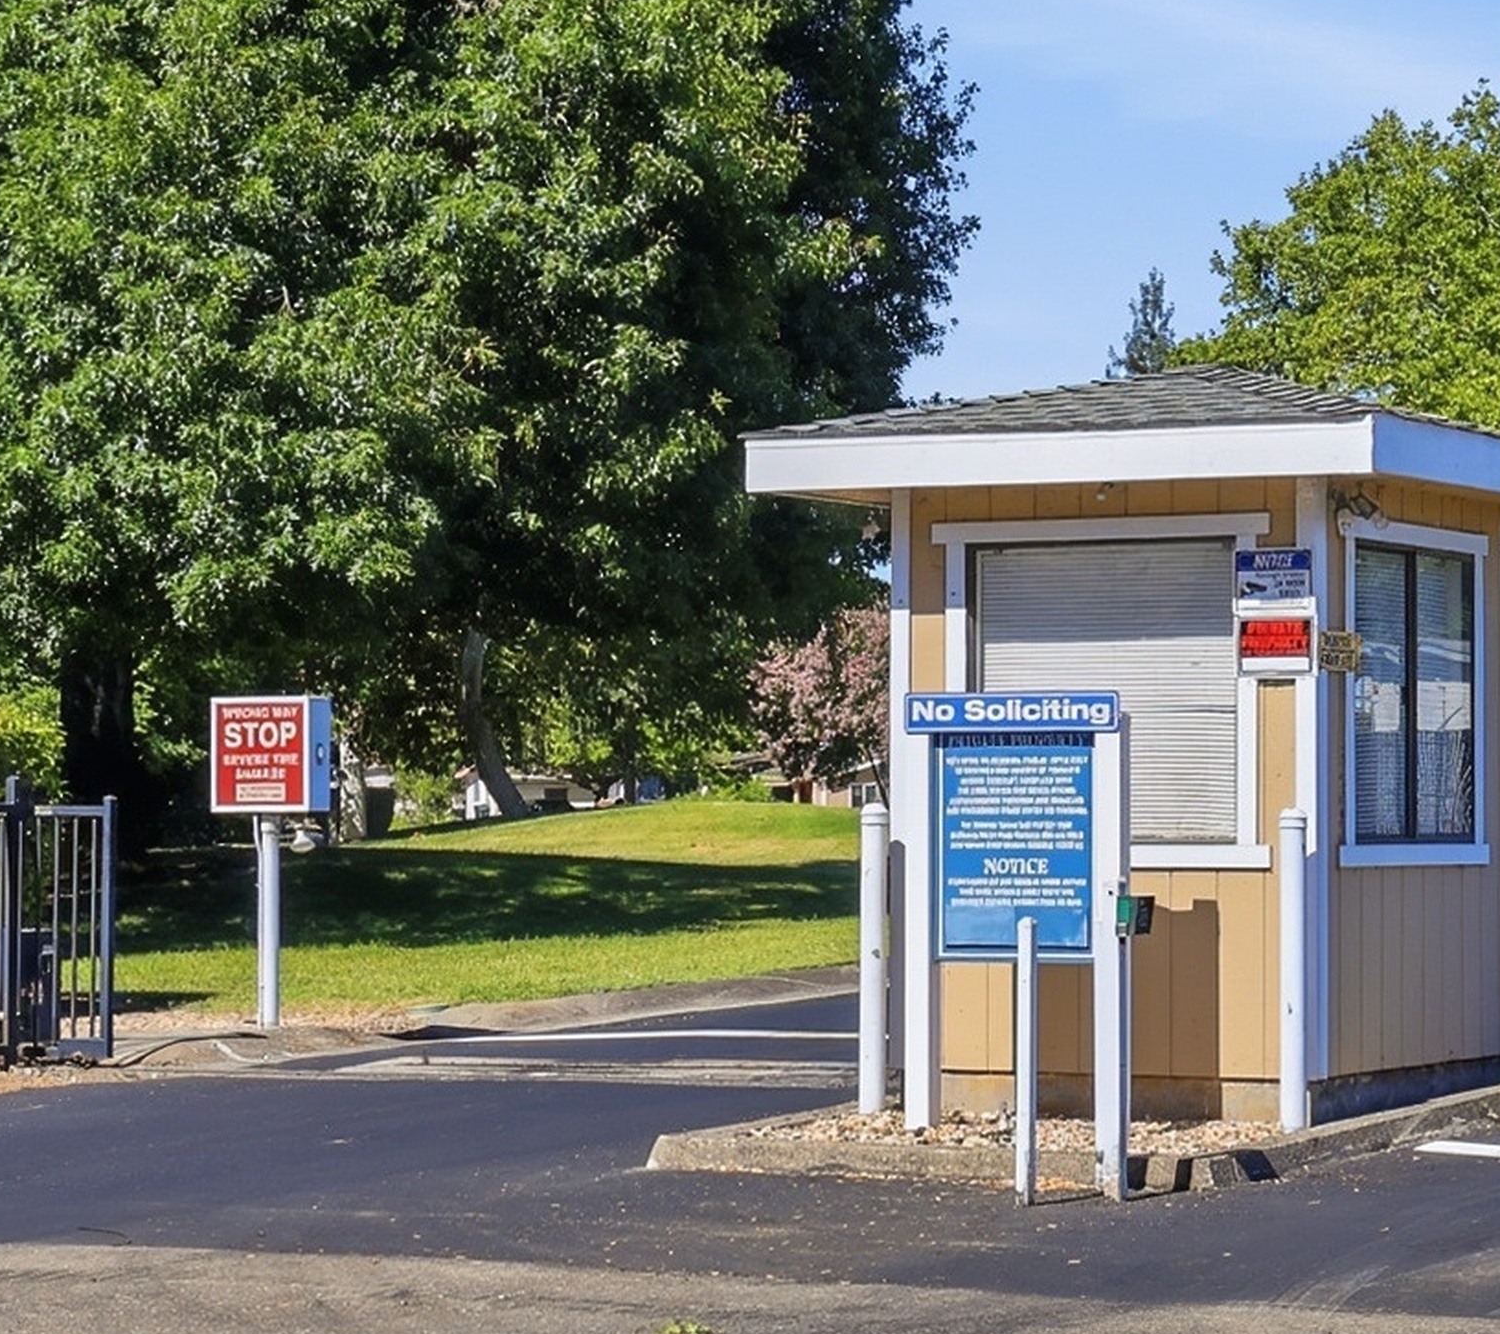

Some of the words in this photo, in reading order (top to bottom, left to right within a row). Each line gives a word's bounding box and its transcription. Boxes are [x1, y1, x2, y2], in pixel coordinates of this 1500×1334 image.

[911, 700, 955, 722] No
[964, 699, 1111, 724] Soliciting
[224, 721, 297, 748] STOP
[983, 858, 1049, 875] NOTICE
